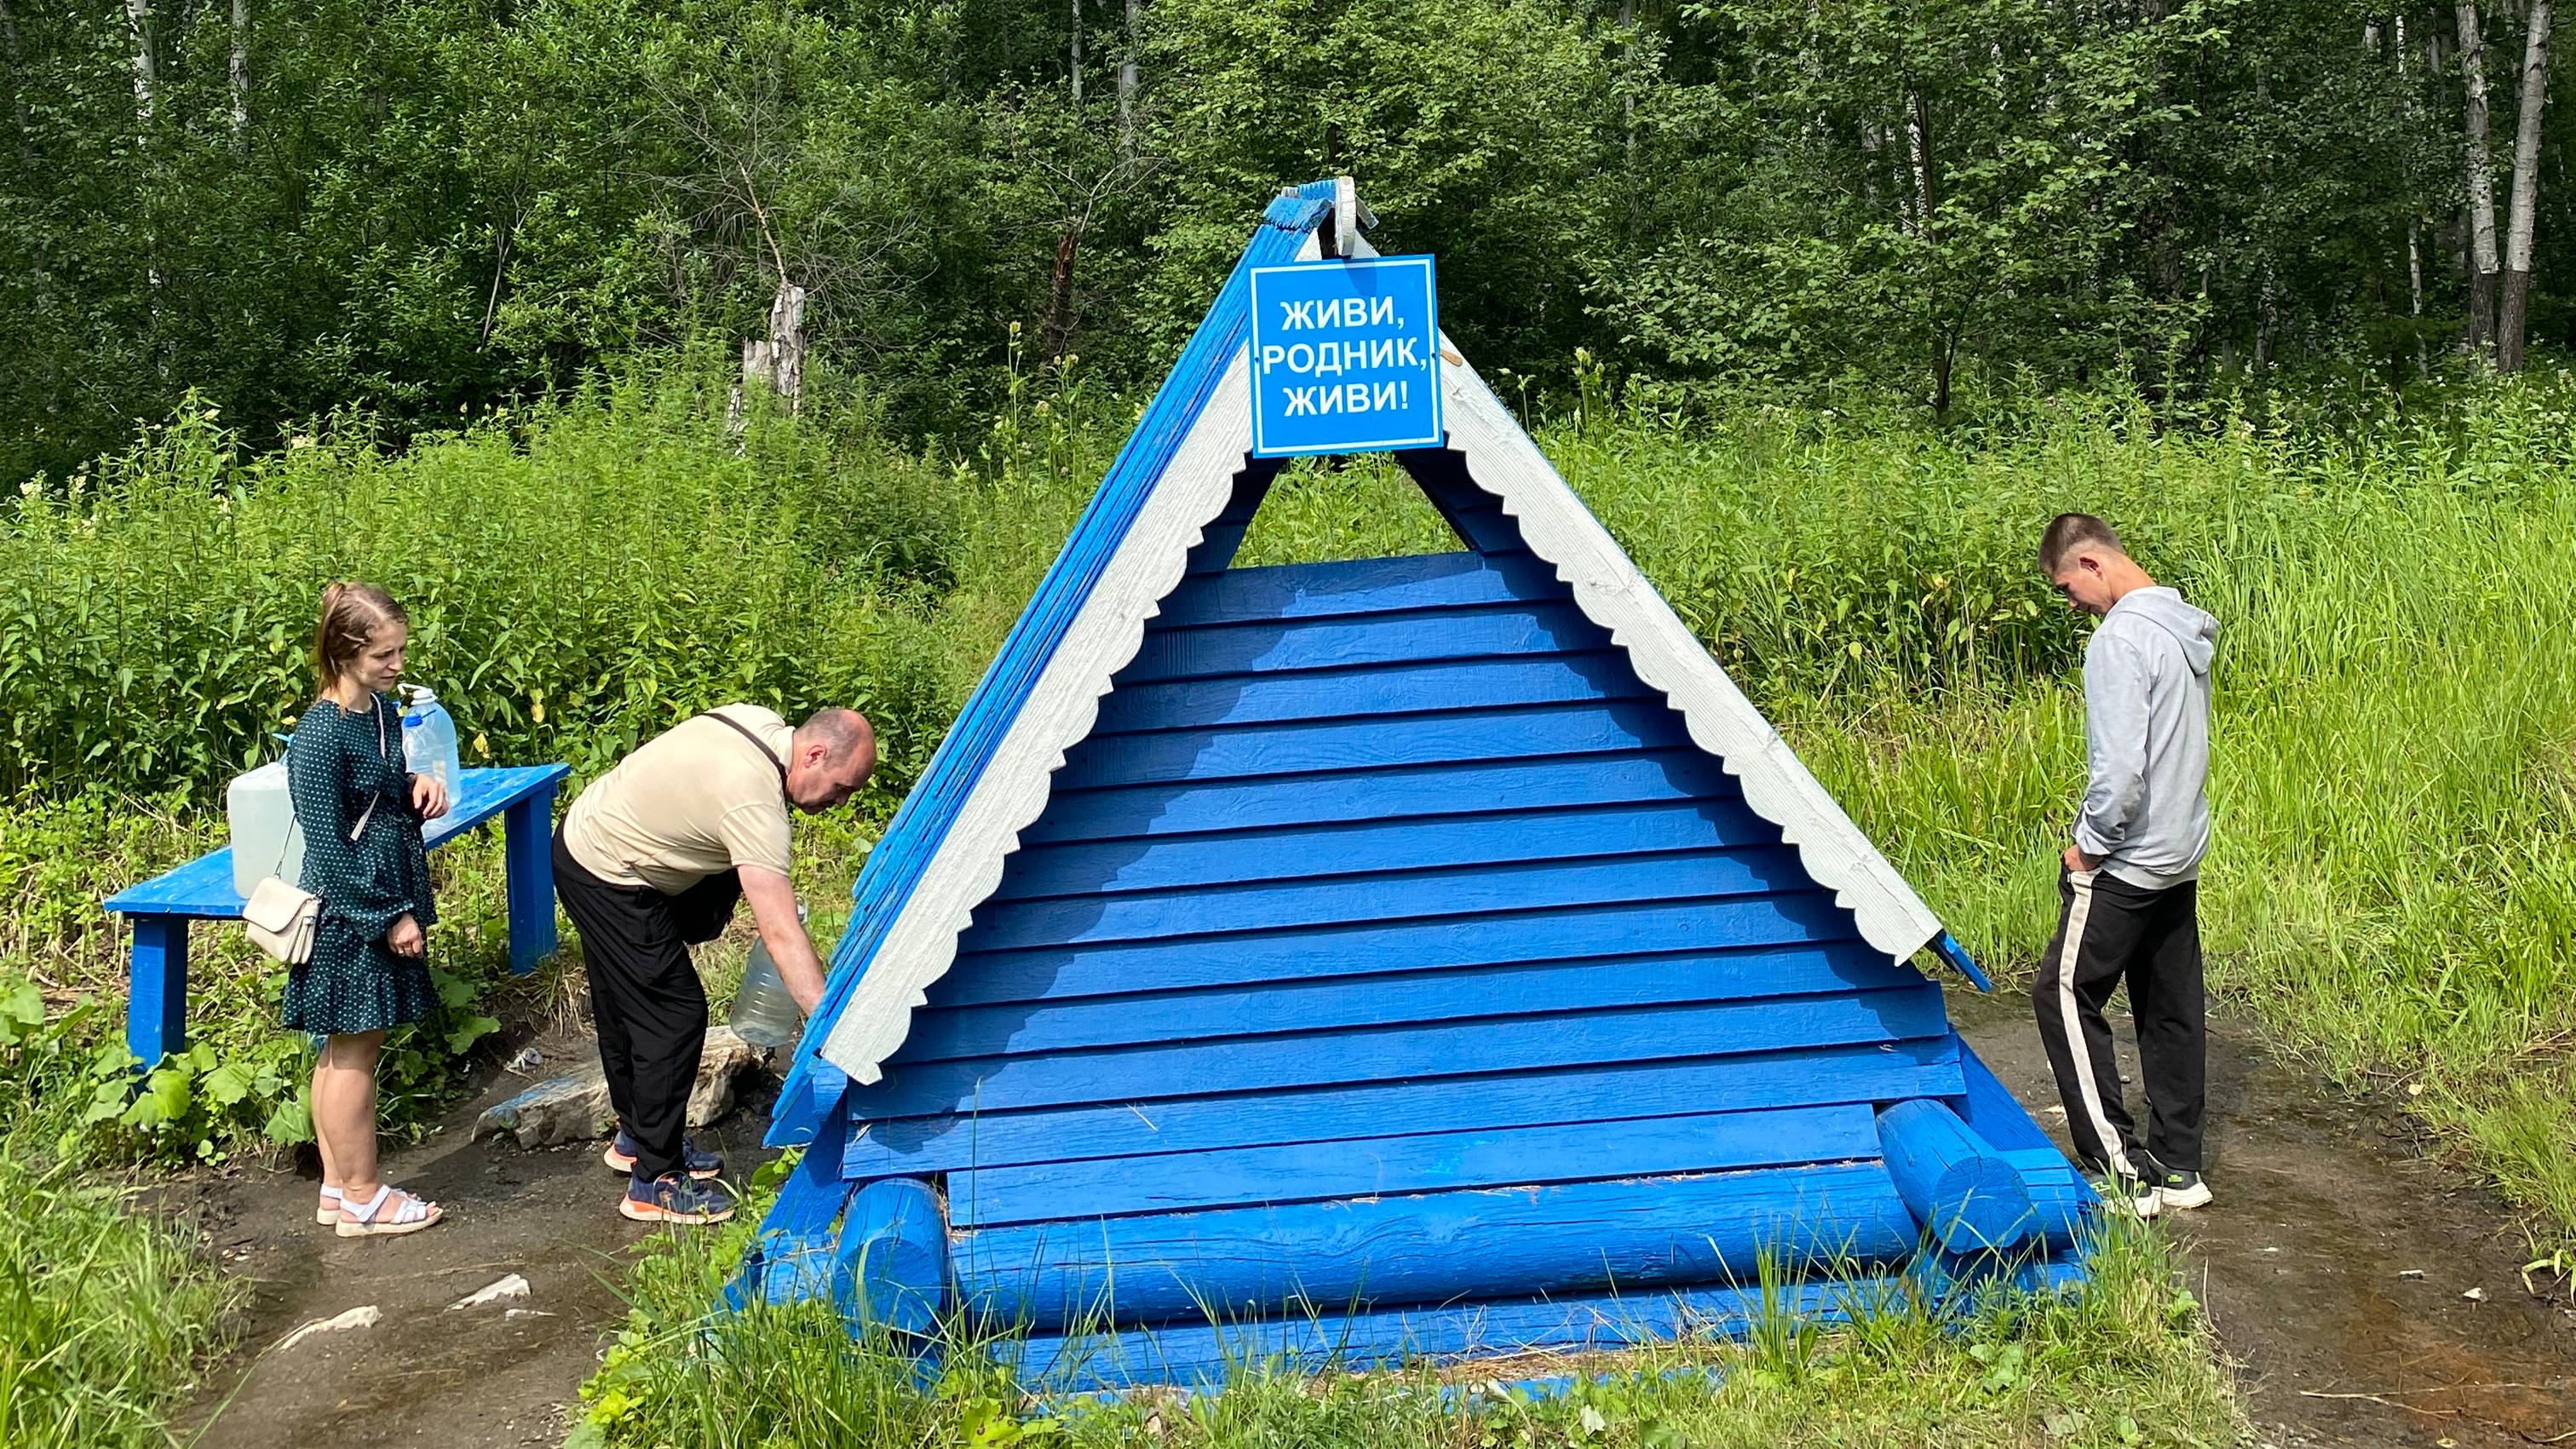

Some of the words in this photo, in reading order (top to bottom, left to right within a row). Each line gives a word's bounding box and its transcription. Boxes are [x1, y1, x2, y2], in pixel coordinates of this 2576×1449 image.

[1279, 296, 1404, 331] ЖИВИ,
[1262, 336, 1427, 377] РОДНИК,
[1283, 381, 1408, 417] ЖИВИ!
